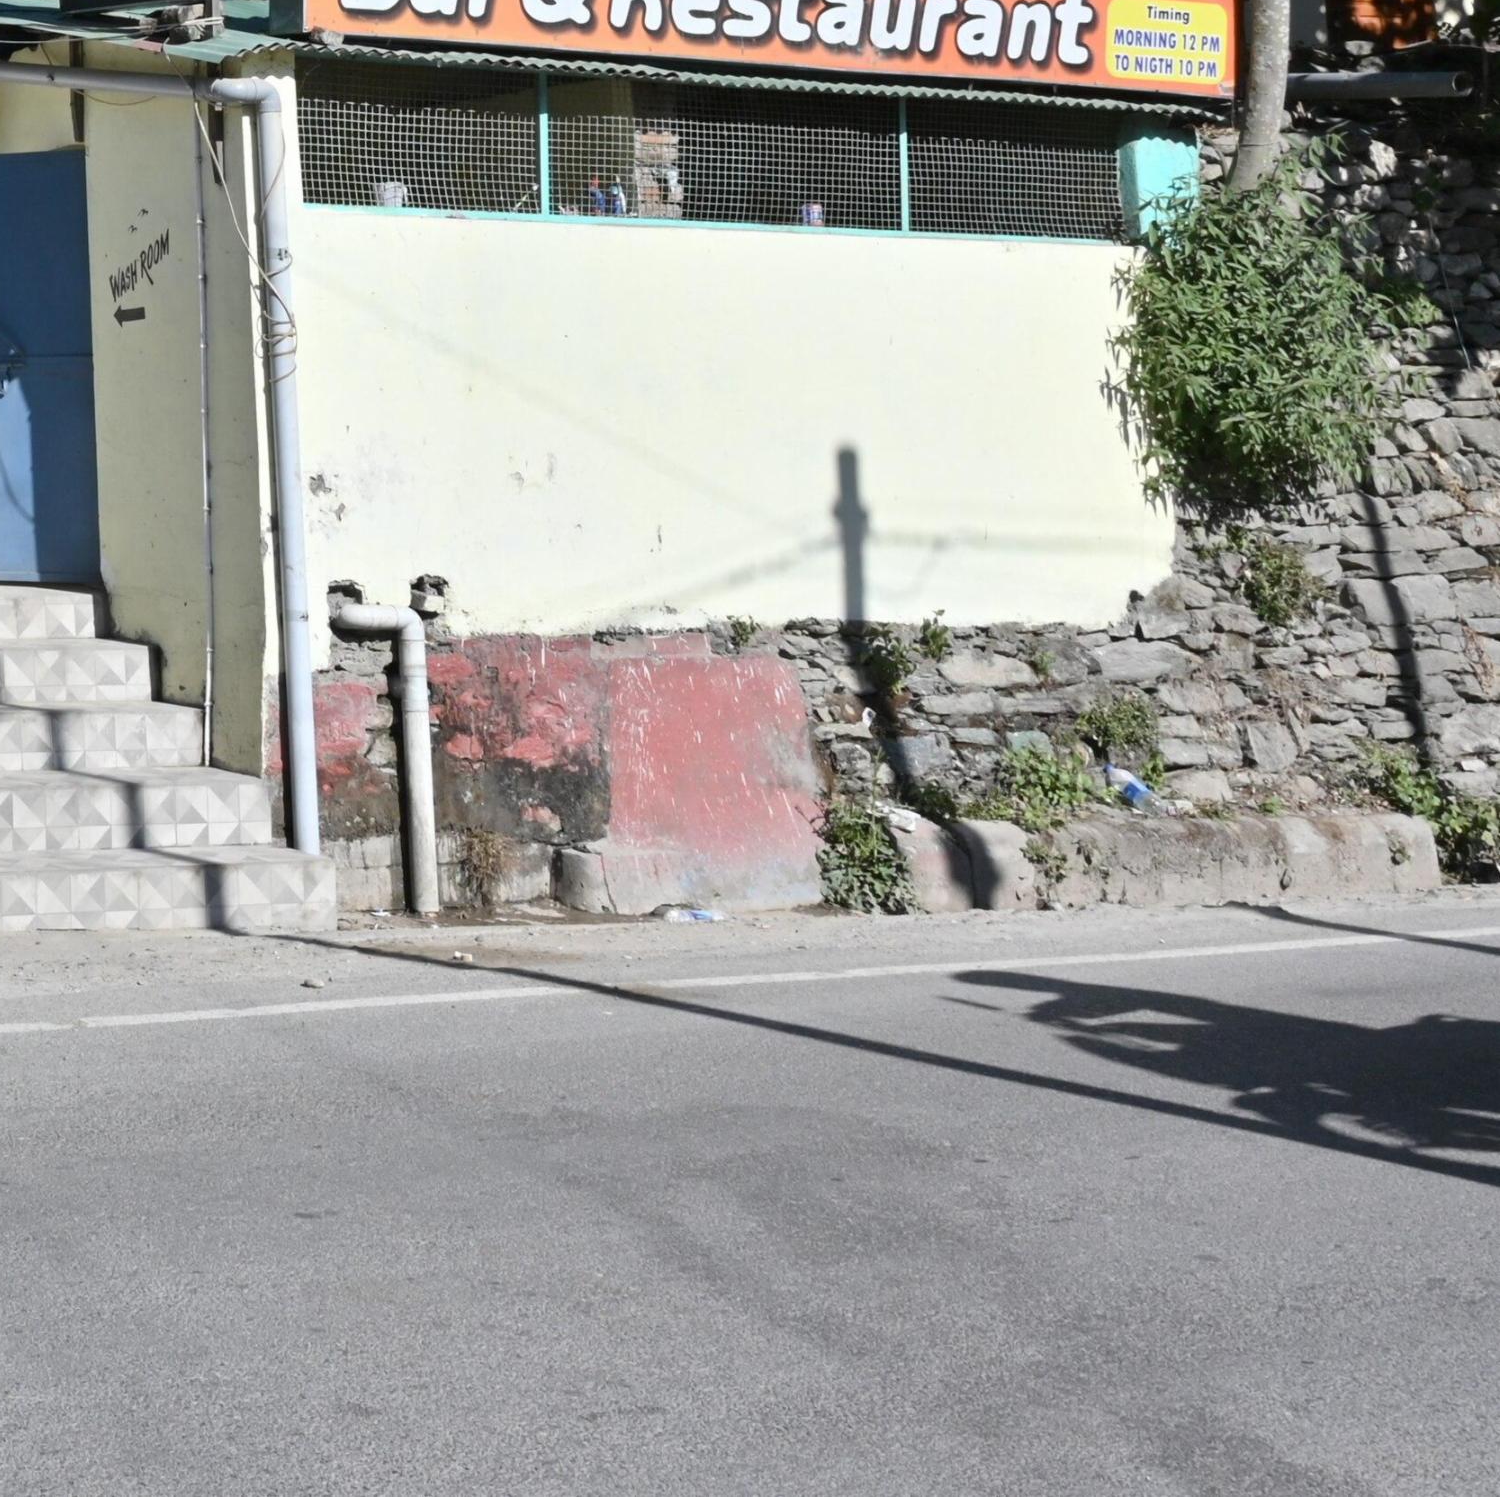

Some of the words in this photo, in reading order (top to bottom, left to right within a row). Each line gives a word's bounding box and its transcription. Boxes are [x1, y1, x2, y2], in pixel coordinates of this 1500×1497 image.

[1147, 4, 1190, 24] Timing
[1113, 28, 1177, 50] MORNING
[1182, 34, 1197, 51] 12
[1200, 35, 1221, 53] PM
[1114, 54, 1131, 71] TO
[1135, 55, 1173, 74] NIGTH
[1177, 59, 1193, 75] 10
[1197, 60, 1217, 78] PM
[109, 259, 138, 303] WASH
[139, 228, 169, 286] ROOM
